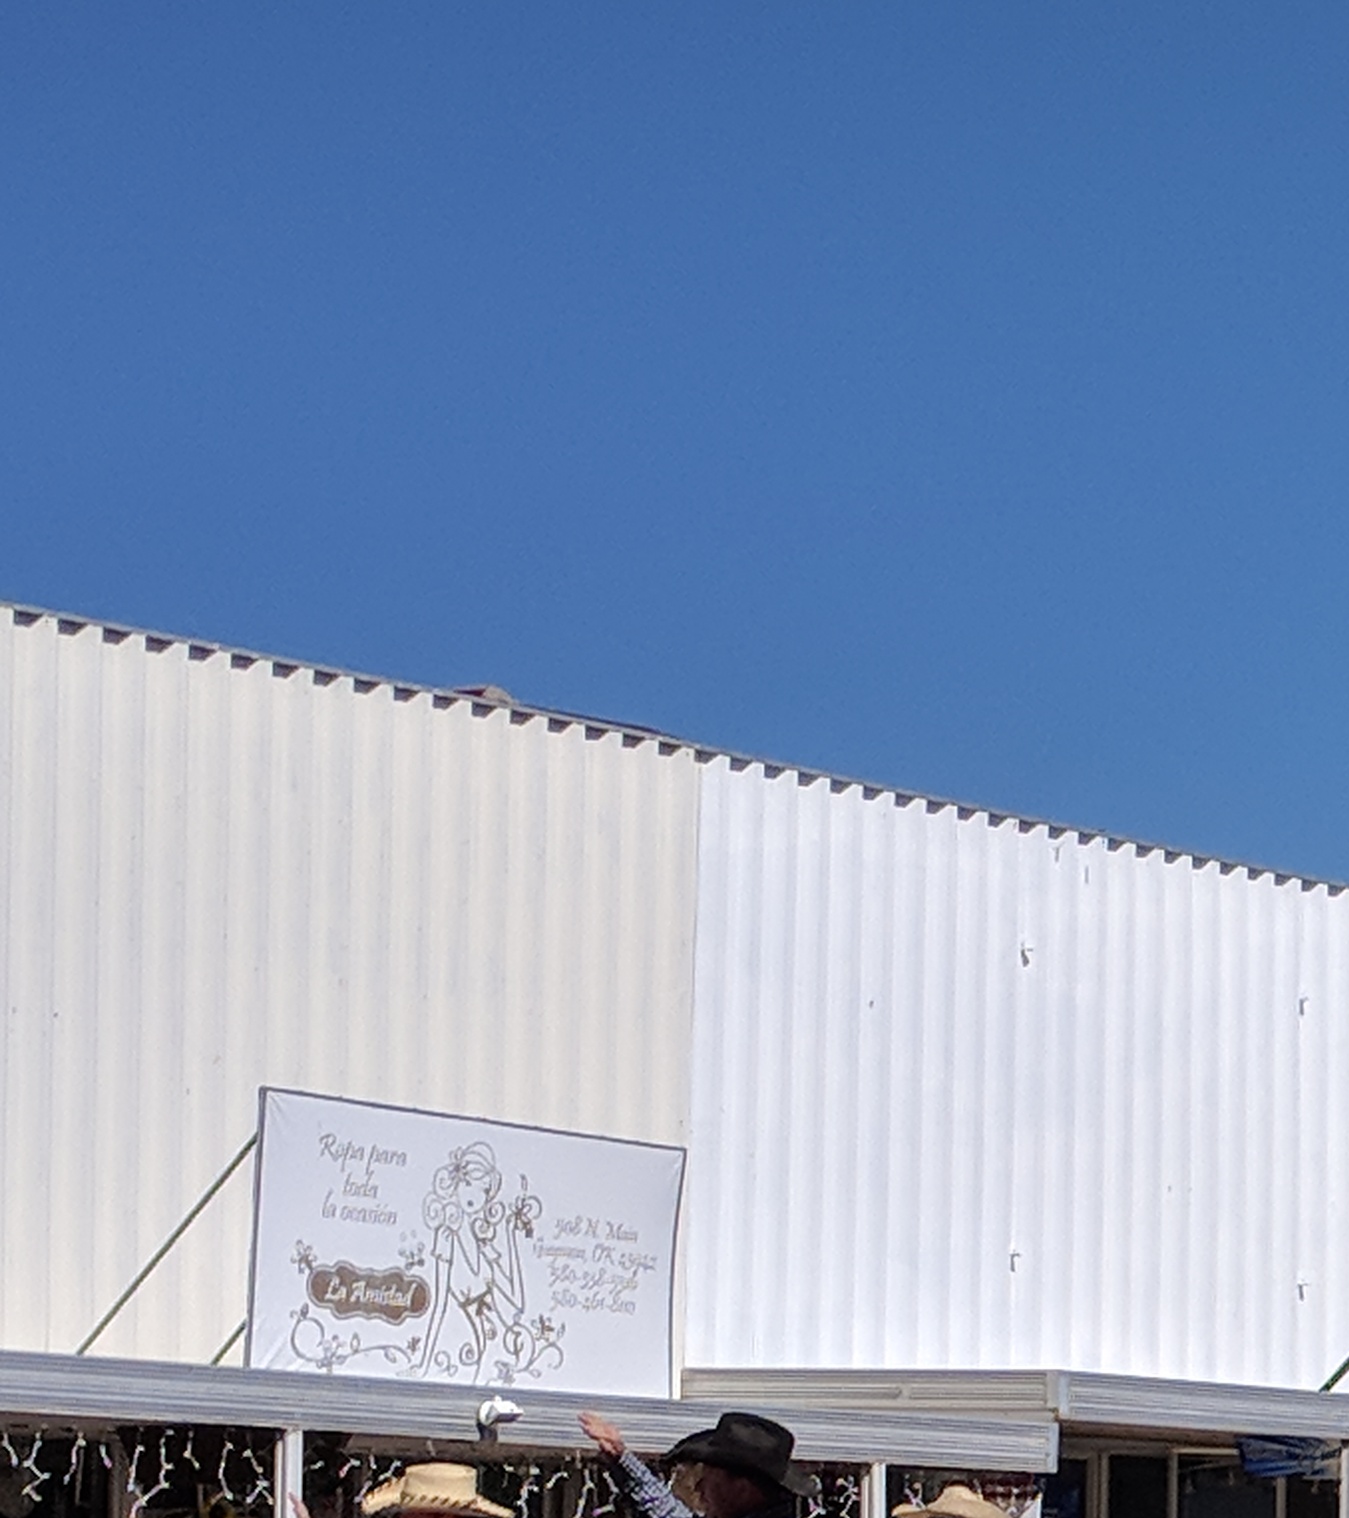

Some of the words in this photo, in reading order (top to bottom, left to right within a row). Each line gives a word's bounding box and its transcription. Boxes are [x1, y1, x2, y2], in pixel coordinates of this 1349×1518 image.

[319, 1133, 364, 1172] Ropa
[365, 1144, 407, 1175] para
[342, 1170, 379, 1199] toda
[324, 1275, 348, 1302] La
